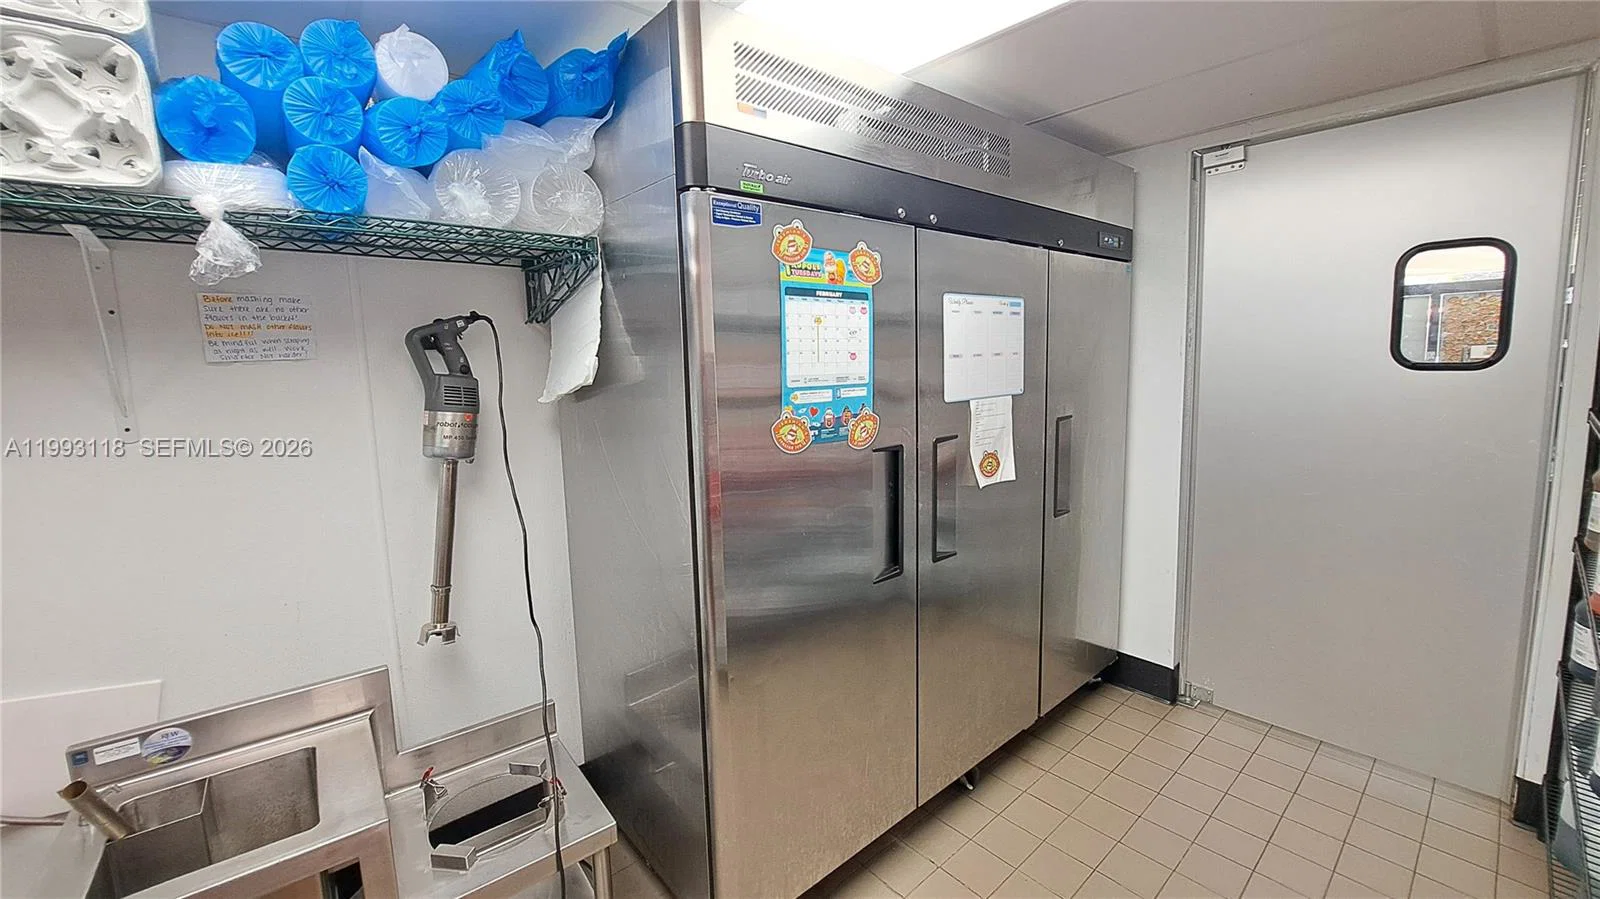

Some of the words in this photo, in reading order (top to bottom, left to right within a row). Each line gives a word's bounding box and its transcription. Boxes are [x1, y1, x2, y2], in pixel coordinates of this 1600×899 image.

[742, 163, 774, 182] Turbo
[775, 174, 792, 185] air
[737, 202, 760, 213] Quality
[815, 290, 843, 298] FEBRUARY
[203, 295, 233, 304] Before
[236, 296, 273, 306] mashing
[279, 296, 301, 304] make
